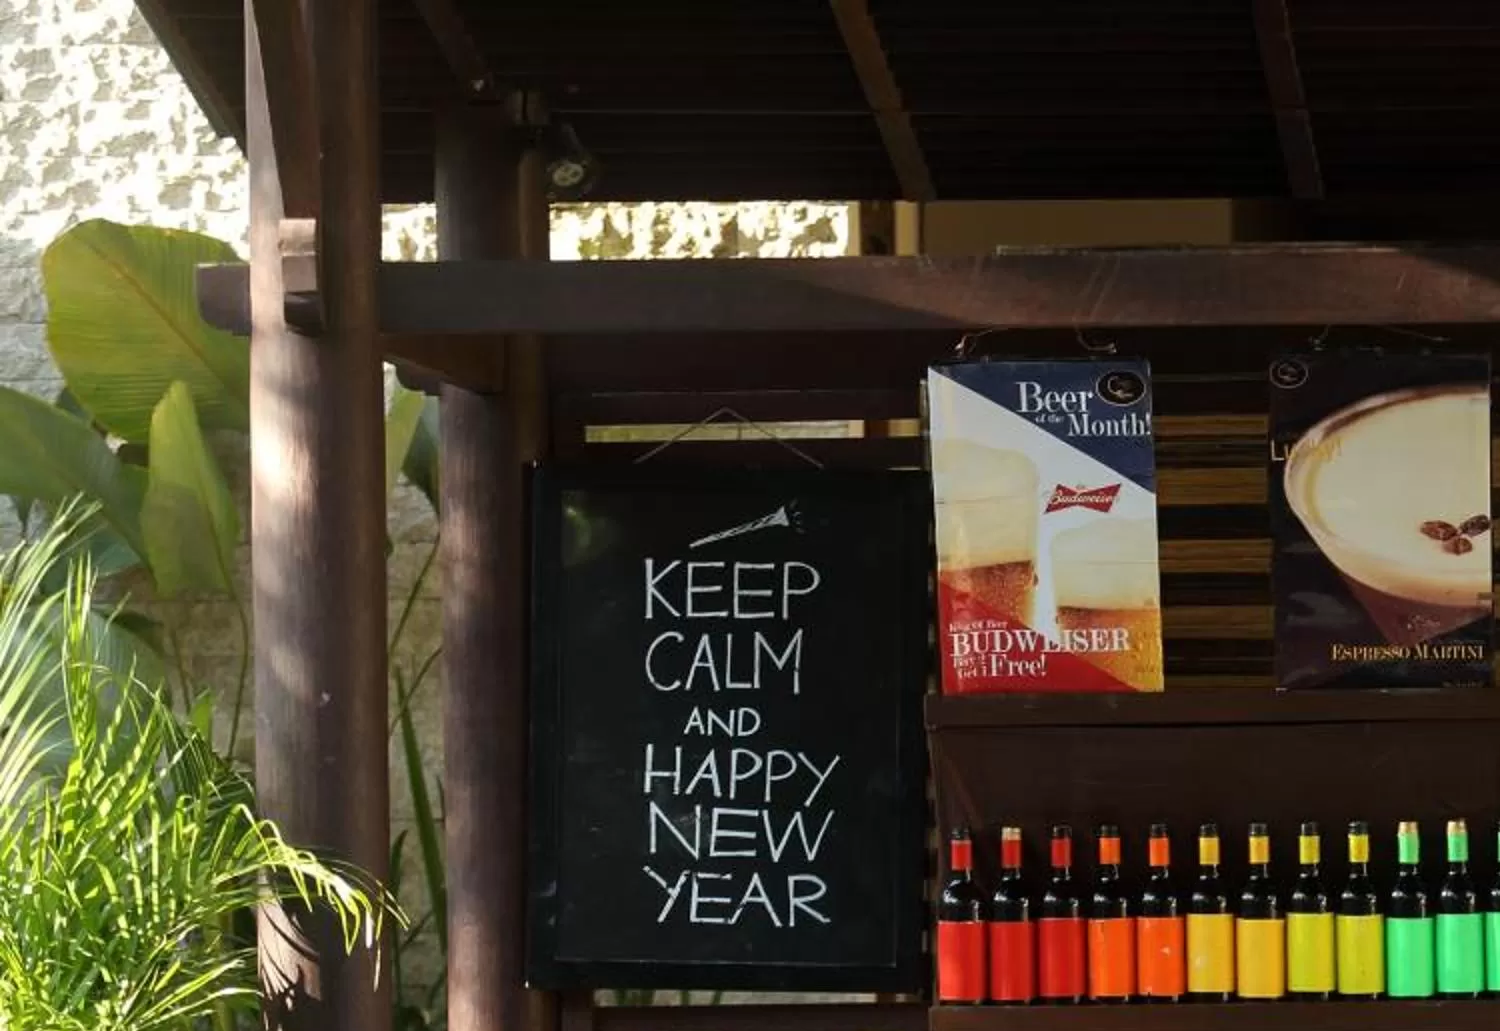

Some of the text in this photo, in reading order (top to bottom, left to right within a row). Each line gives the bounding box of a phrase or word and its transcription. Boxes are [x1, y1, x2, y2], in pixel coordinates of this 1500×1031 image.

[1015, 380, 1093, 413] Beer
[1067, 412, 1152, 437] Month!
[644, 558, 821, 621] KEEP
[949, 627, 1131, 658] BUDWEISER
[1414, 642, 1485, 660] MARTINI
[645, 628, 804, 694] CALM
[990, 653, 1048, 678] Free!
[684, 706, 761, 738] AND
[644, 743, 841, 807] HAPPY
[648, 801, 835, 863] NEW
[642, 866, 832, 928] YEAR
